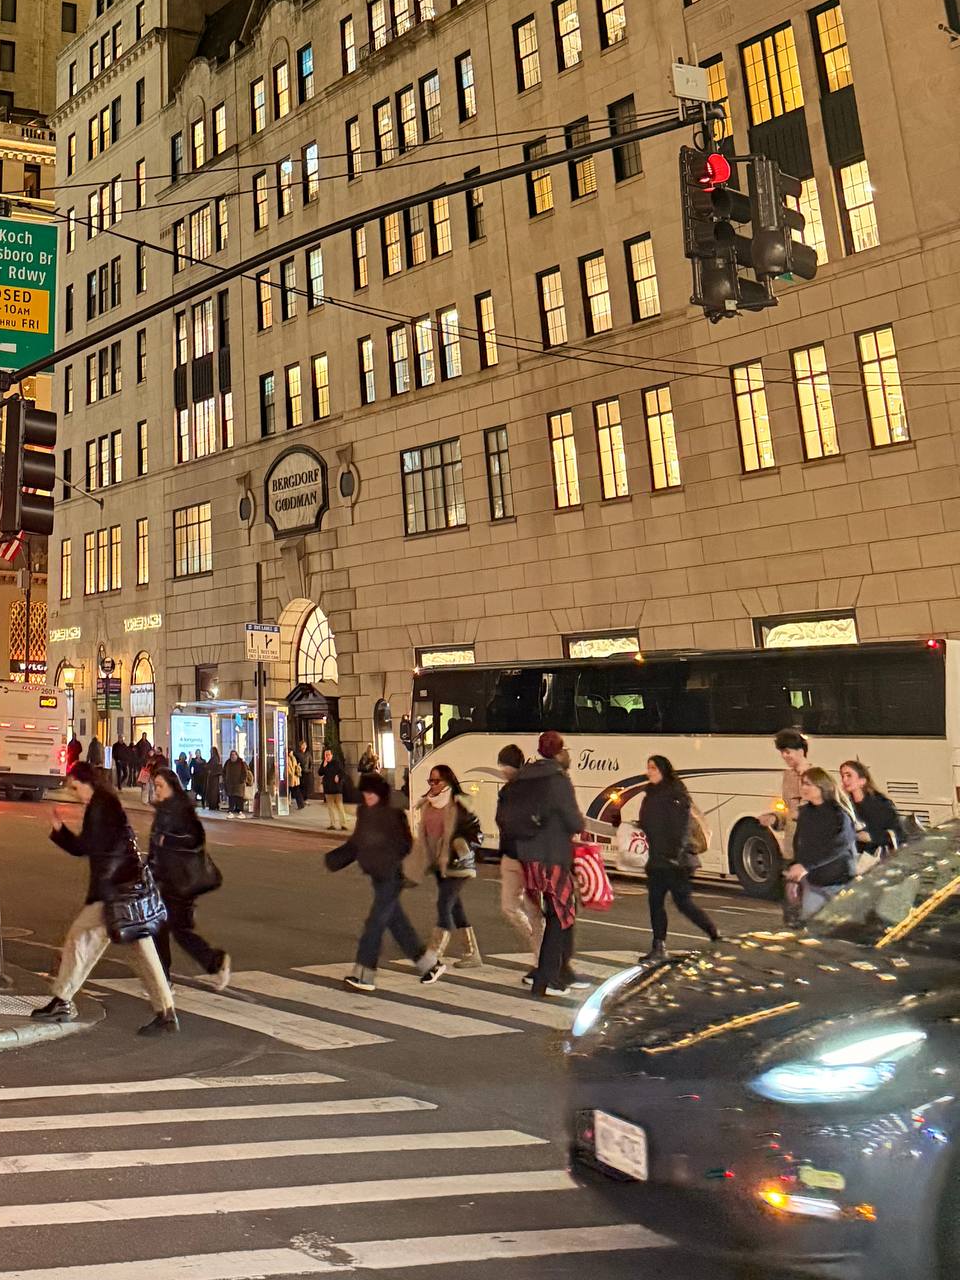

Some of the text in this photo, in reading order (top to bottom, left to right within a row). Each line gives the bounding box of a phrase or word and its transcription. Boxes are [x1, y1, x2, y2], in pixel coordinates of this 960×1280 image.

[0, 228, 33, 245] Koch
[39, 251, 53, 265] Br
[8, 265, 46, 286] Rdwy
[21, 318, 40, 329] FRI
[272, 468, 320, 493] BERGDORF
[275, 491, 317, 513] GOODMAN
[577, 748, 620, 771] Tours
